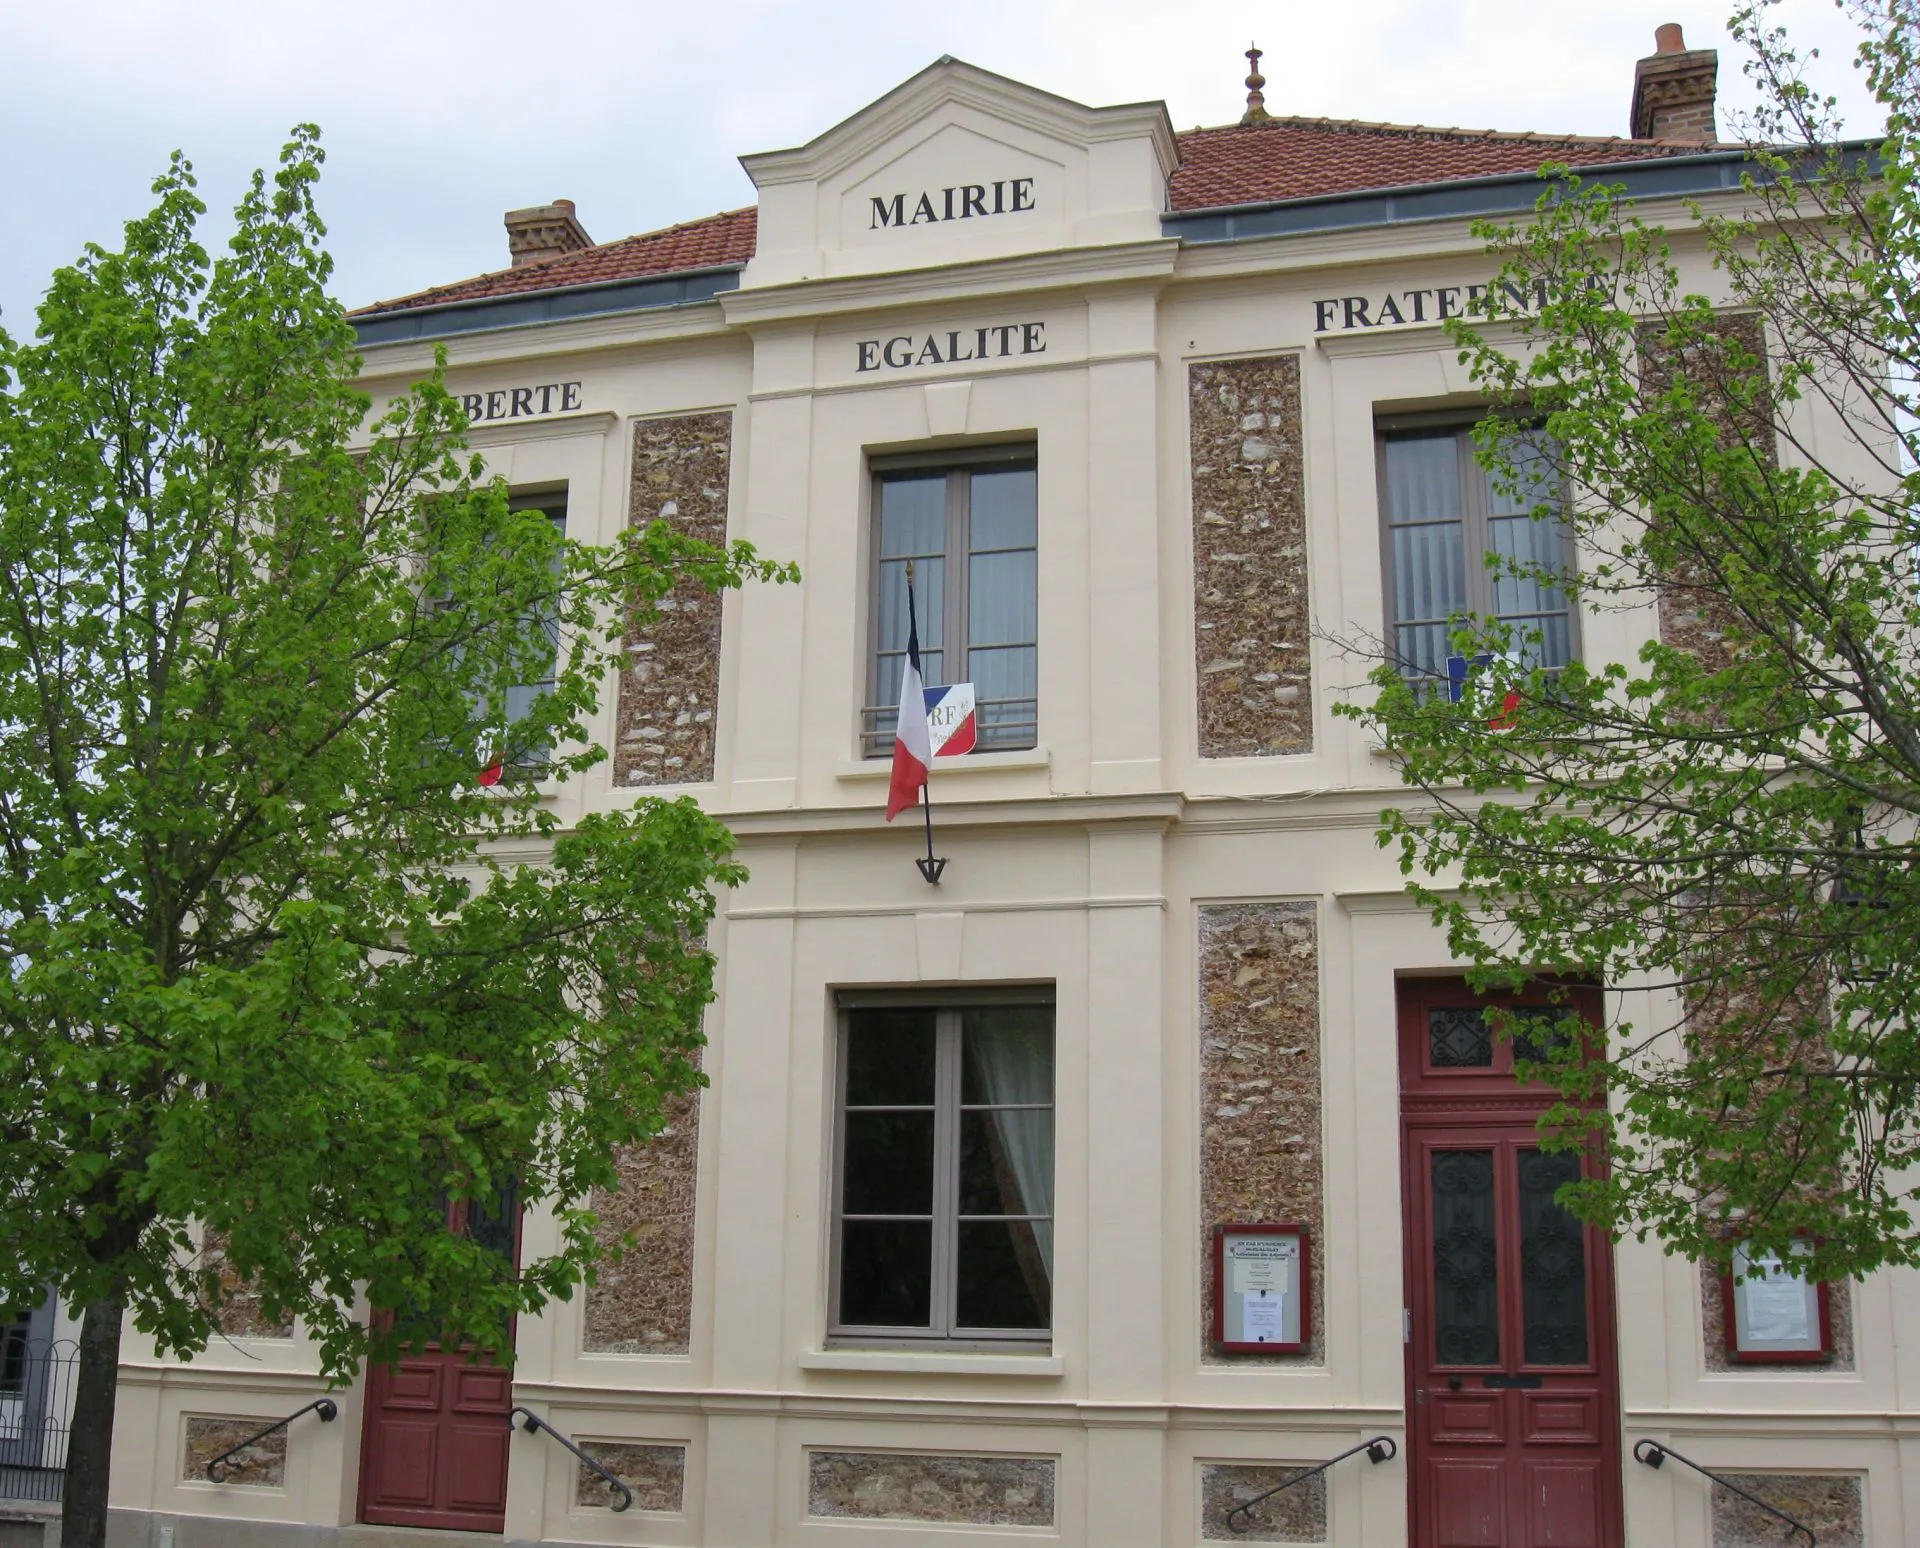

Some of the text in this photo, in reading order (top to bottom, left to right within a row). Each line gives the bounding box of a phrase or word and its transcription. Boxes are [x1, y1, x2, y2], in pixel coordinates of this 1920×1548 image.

[868, 177, 1037, 230] MAIRIE
[1312, 272, 1614, 332] FRATERNIE
[855, 322, 1048, 372] EGALITE
[931, 705, 956, 726] RF
